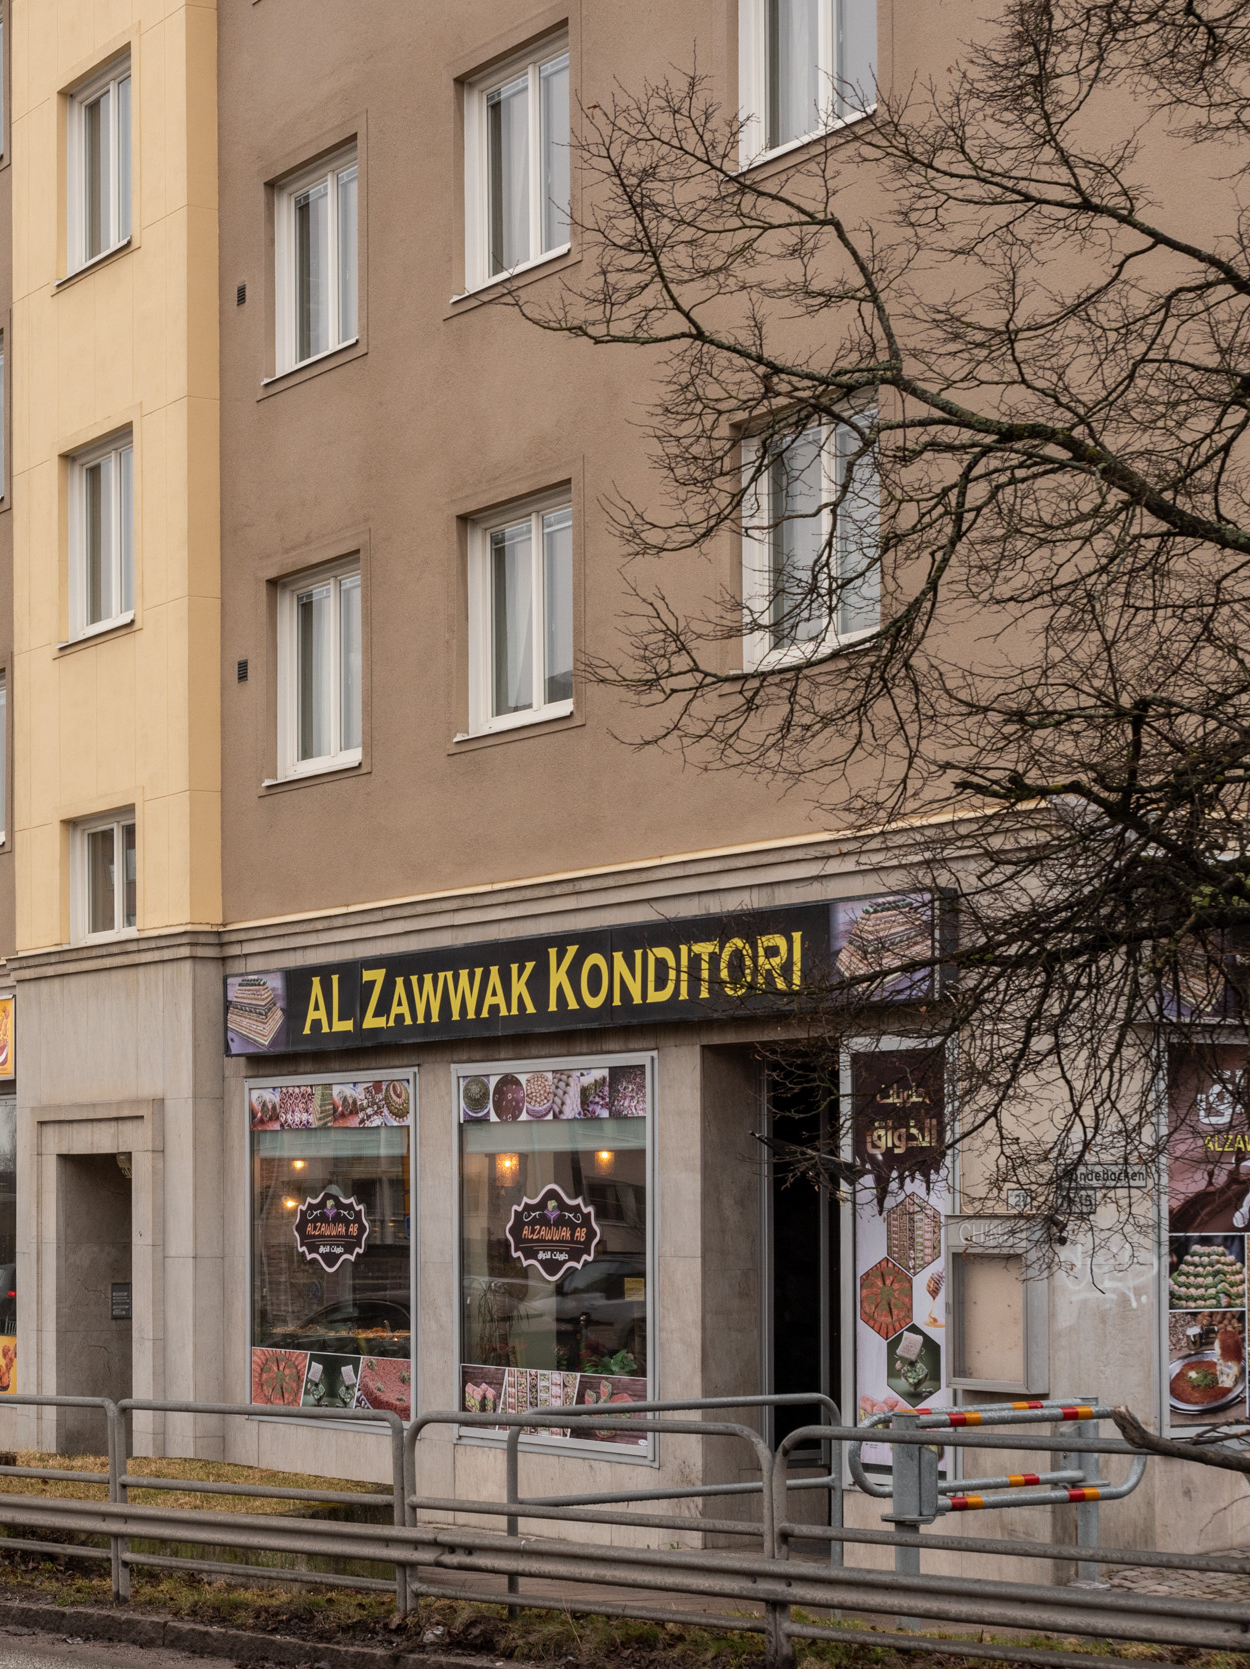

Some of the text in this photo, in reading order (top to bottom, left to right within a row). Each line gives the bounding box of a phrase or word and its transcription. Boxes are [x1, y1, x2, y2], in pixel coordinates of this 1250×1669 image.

[302, 931, 803, 1035] AL ZAWWAK KONDITORI
[306, 1222, 358, 1236] ALZAWWAK AB
[522, 1225, 587, 1242] ALZAWWAK AB
